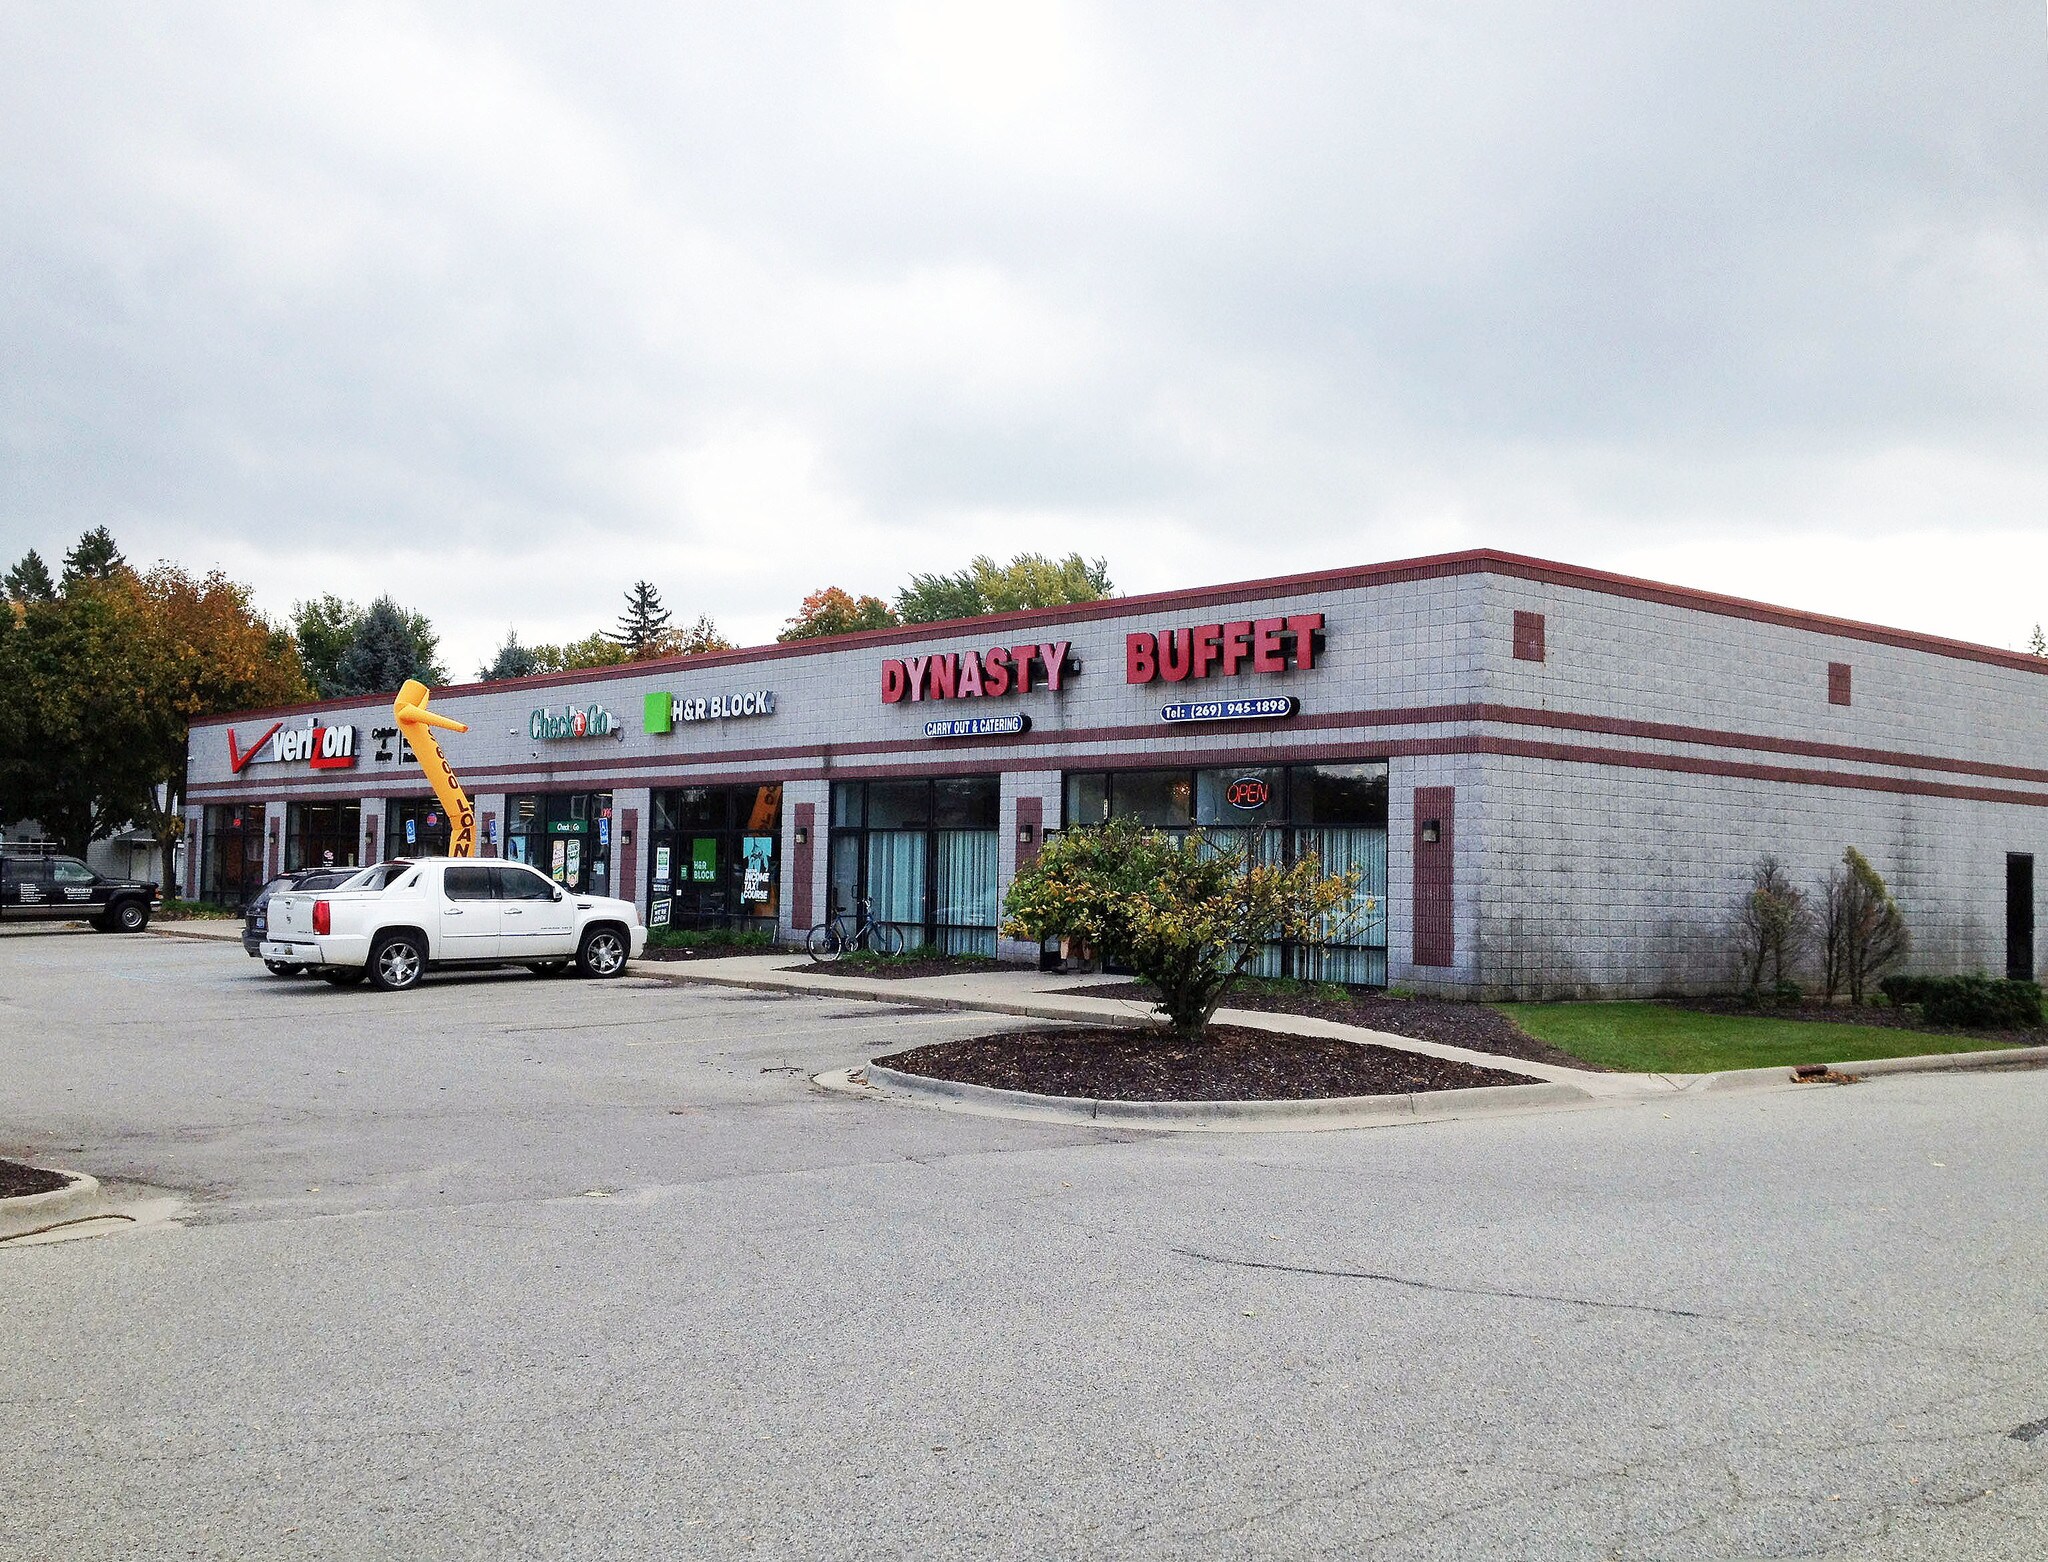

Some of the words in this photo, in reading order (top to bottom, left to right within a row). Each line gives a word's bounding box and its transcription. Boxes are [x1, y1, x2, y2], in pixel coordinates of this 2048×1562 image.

[1126, 613, 1325, 684] BUFFET
[881, 641, 1072, 703] DYNASTY
[672, 698, 706, 722] H&R
[710, 690, 768, 718] BLOCK
[1164, 707, 1185, 719] Tel:
[1190, 703, 1222, 719] (269)
[1227, 699, 1286, 715] 945-1898
[529, 705, 576, 740] Check
[587, 703, 608, 736] Go
[926, 722, 952, 736] CARRY
[953, 720, 971, 734] OUT
[972, 719, 979, 733] &
[979, 716, 1019, 732] CATERING
[272, 717, 356, 769] verizon
[1226, 782, 1270, 804] OPEN
[452, 798, 475, 858] LOAN
[693, 869, 716, 880] BLOCK
[744, 871, 770, 883] INCOME
[743, 881, 757, 891] TAX
[743, 889, 769, 900] COURSE
